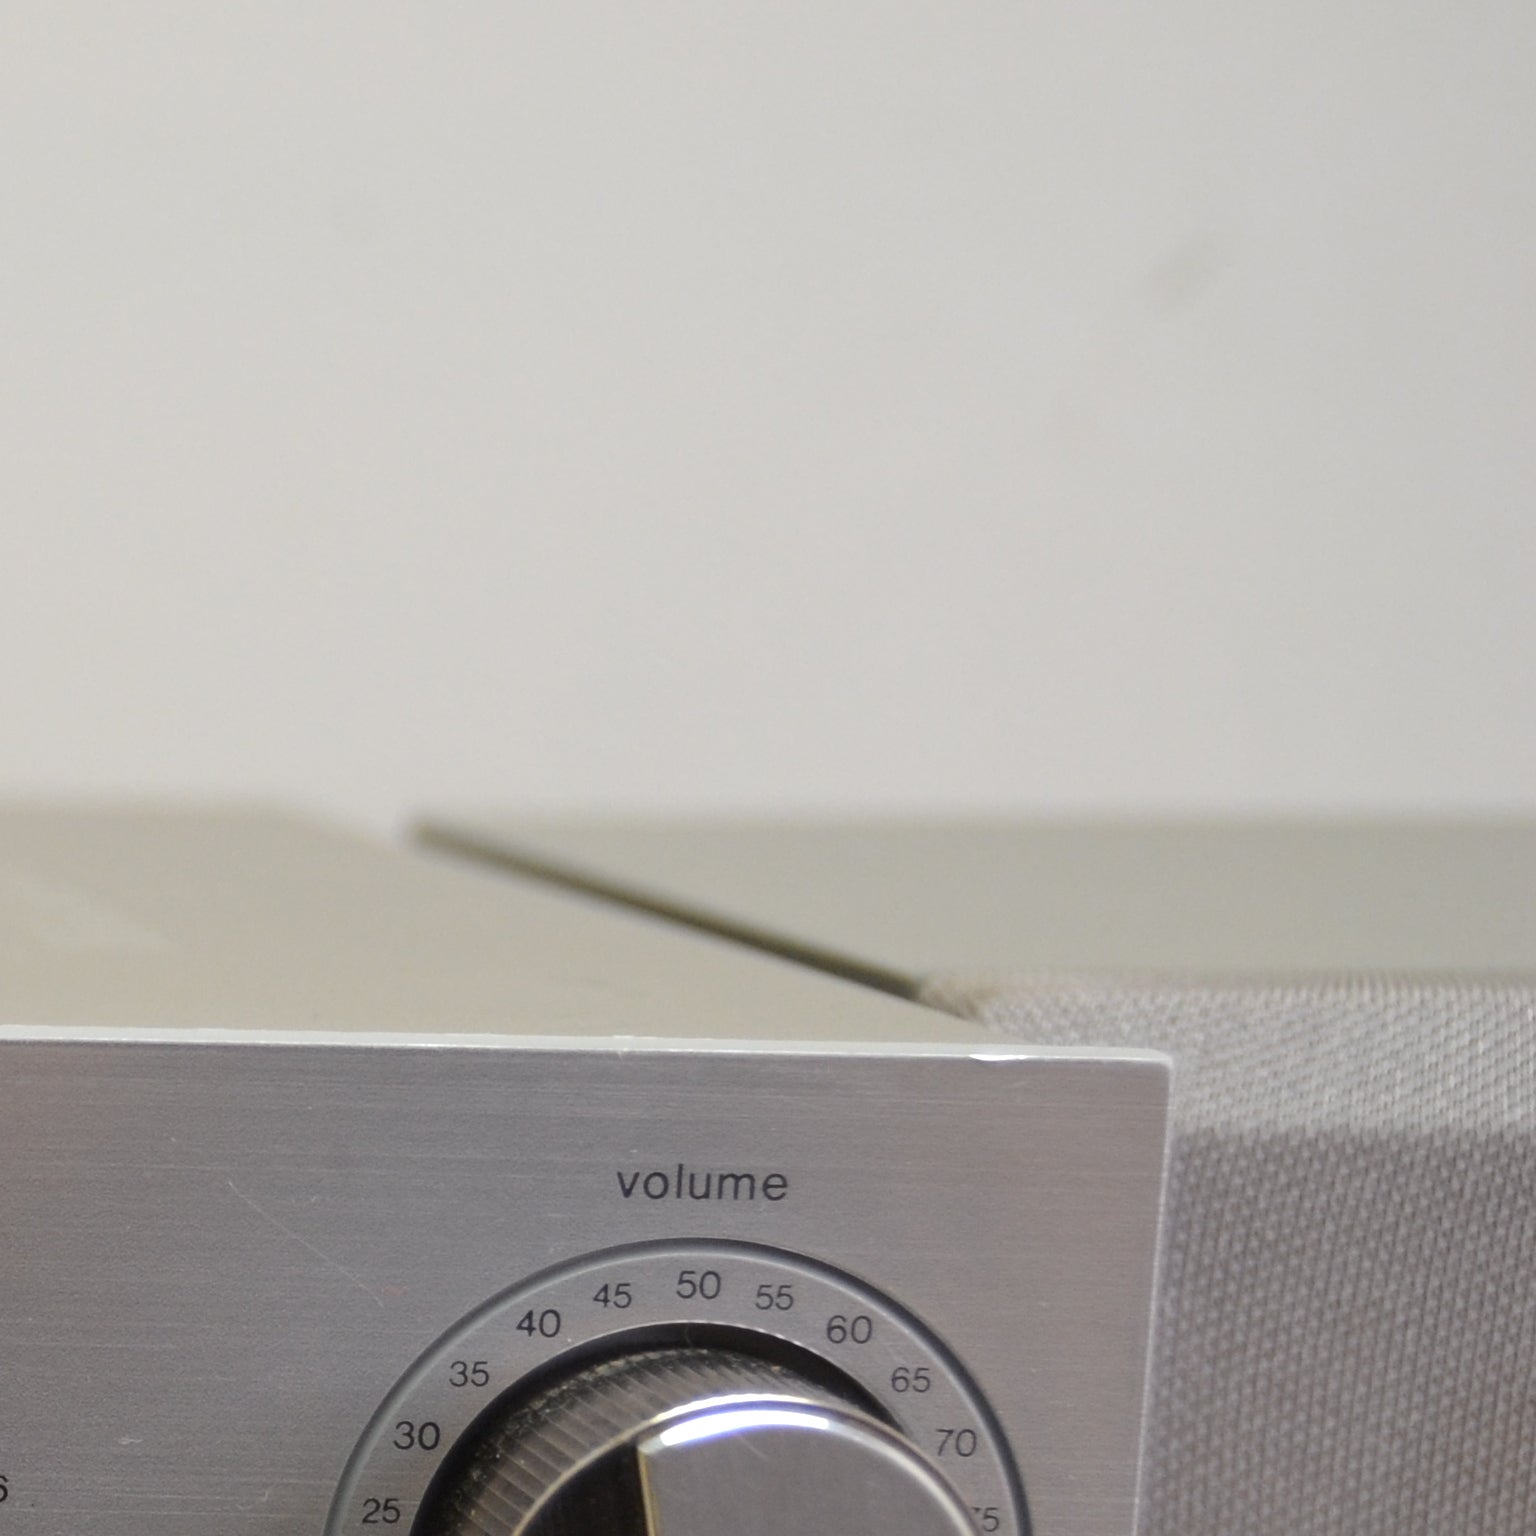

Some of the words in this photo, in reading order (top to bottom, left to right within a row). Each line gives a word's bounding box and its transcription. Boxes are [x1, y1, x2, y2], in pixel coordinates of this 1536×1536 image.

[616, 1163, 789, 1202] volume
[592, 1282, 633, 1309] 45
[676, 1269, 722, 1301] 50
[755, 1283, 795, 1312] 55
[515, 1308, 562, 1338] 40
[825, 1314, 874, 1345] 60
[449, 1360, 491, 1388] 35
[890, 1366, 932, 1394] 65
[393, 1420, 442, 1452] 30
[936, 1427, 978, 1458] 70
[361, 1497, 402, 1525] 25
[971, 1506, 1001, 1533] 5
